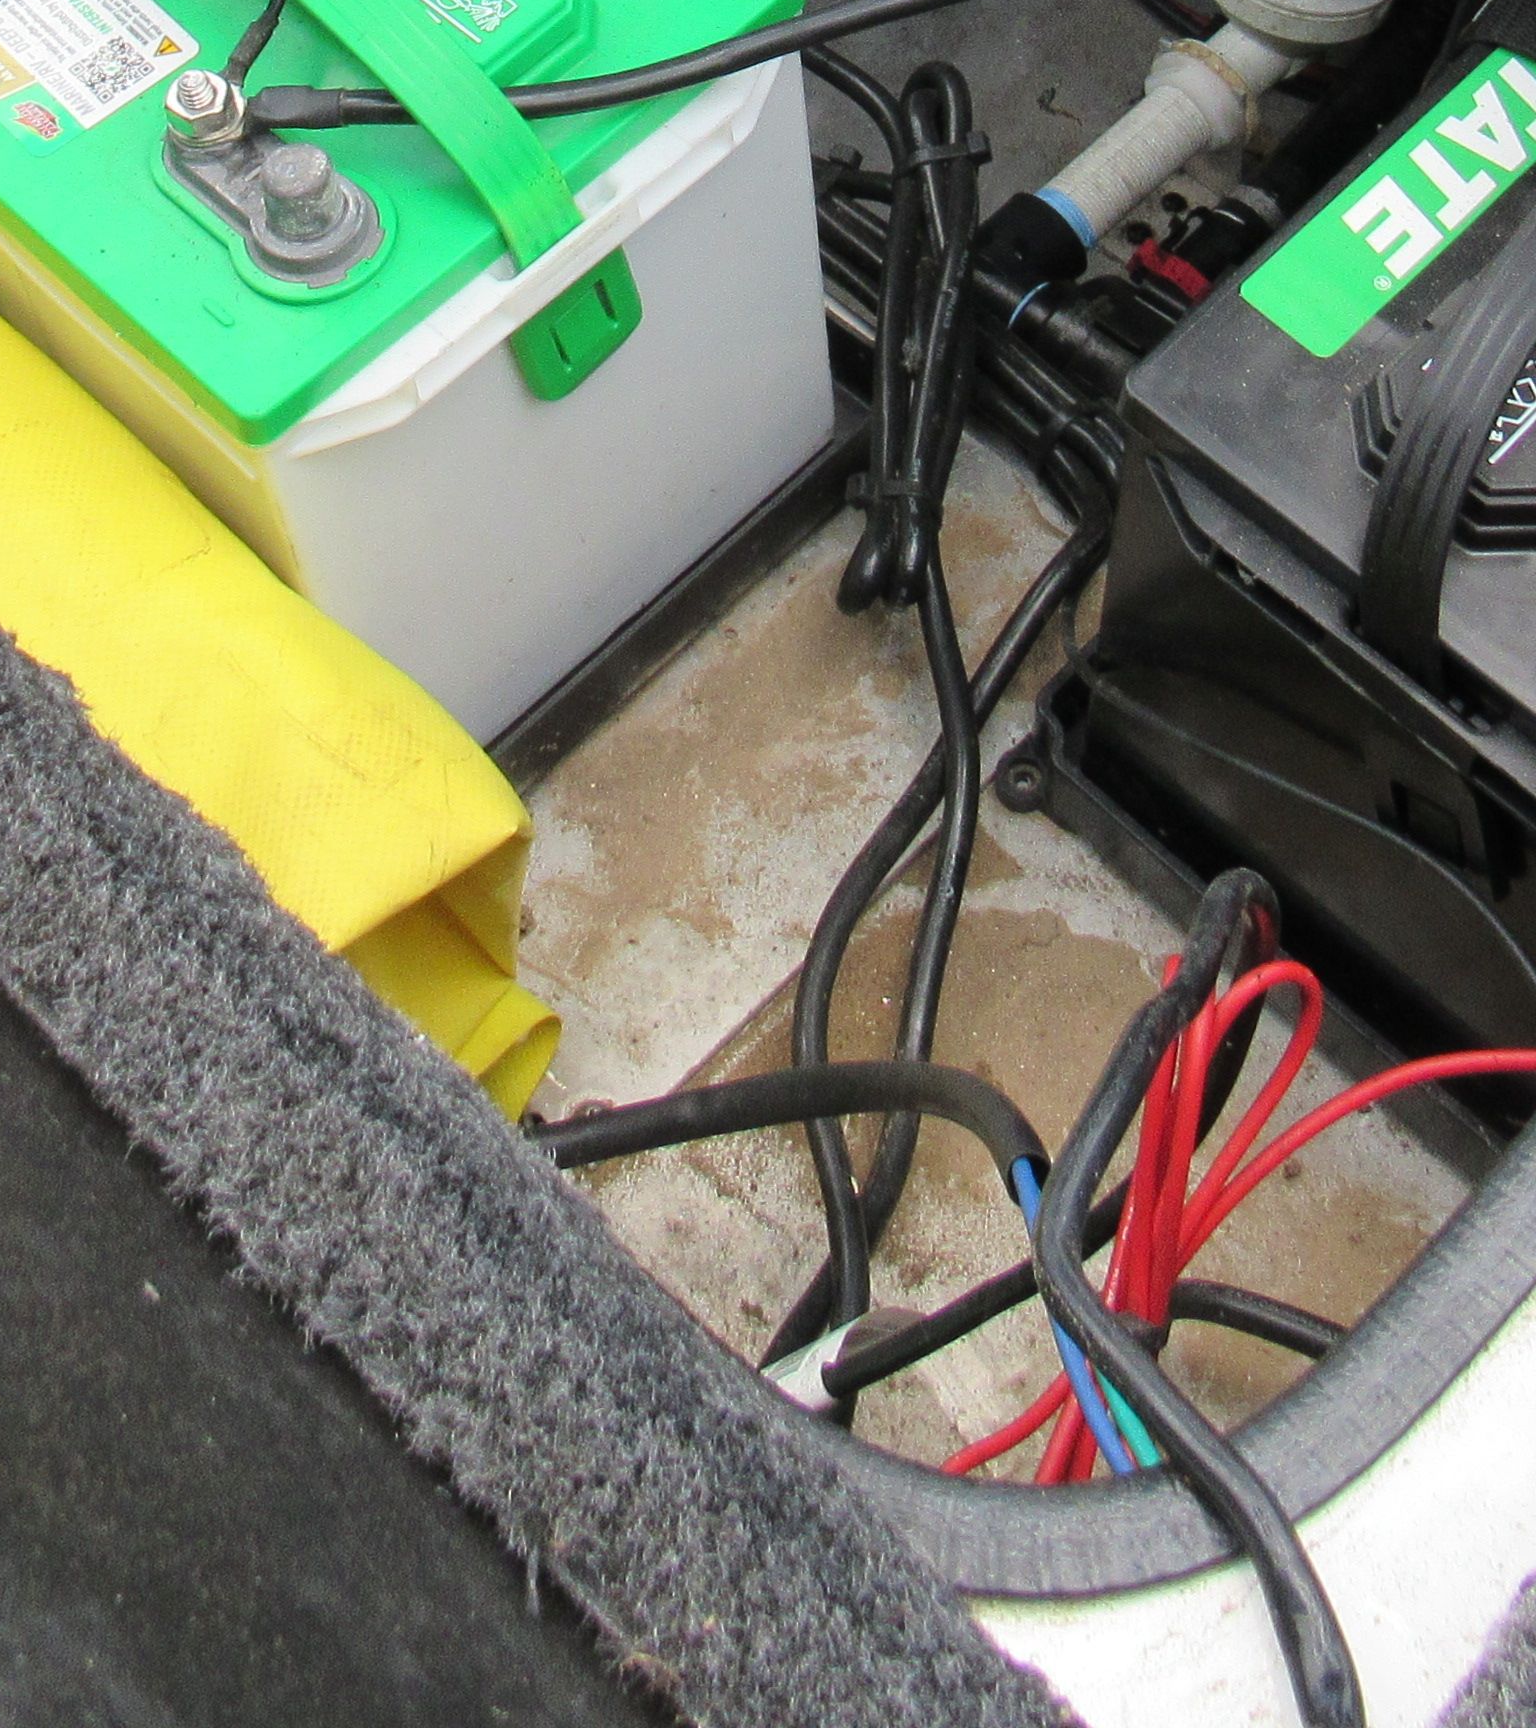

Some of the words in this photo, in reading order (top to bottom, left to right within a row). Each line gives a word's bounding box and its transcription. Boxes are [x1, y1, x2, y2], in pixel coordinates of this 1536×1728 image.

[43, 0, 62, 13] by
[52, 9, 94, 47] Distributed
[29, 56, 97, 118] MARINE/RV
